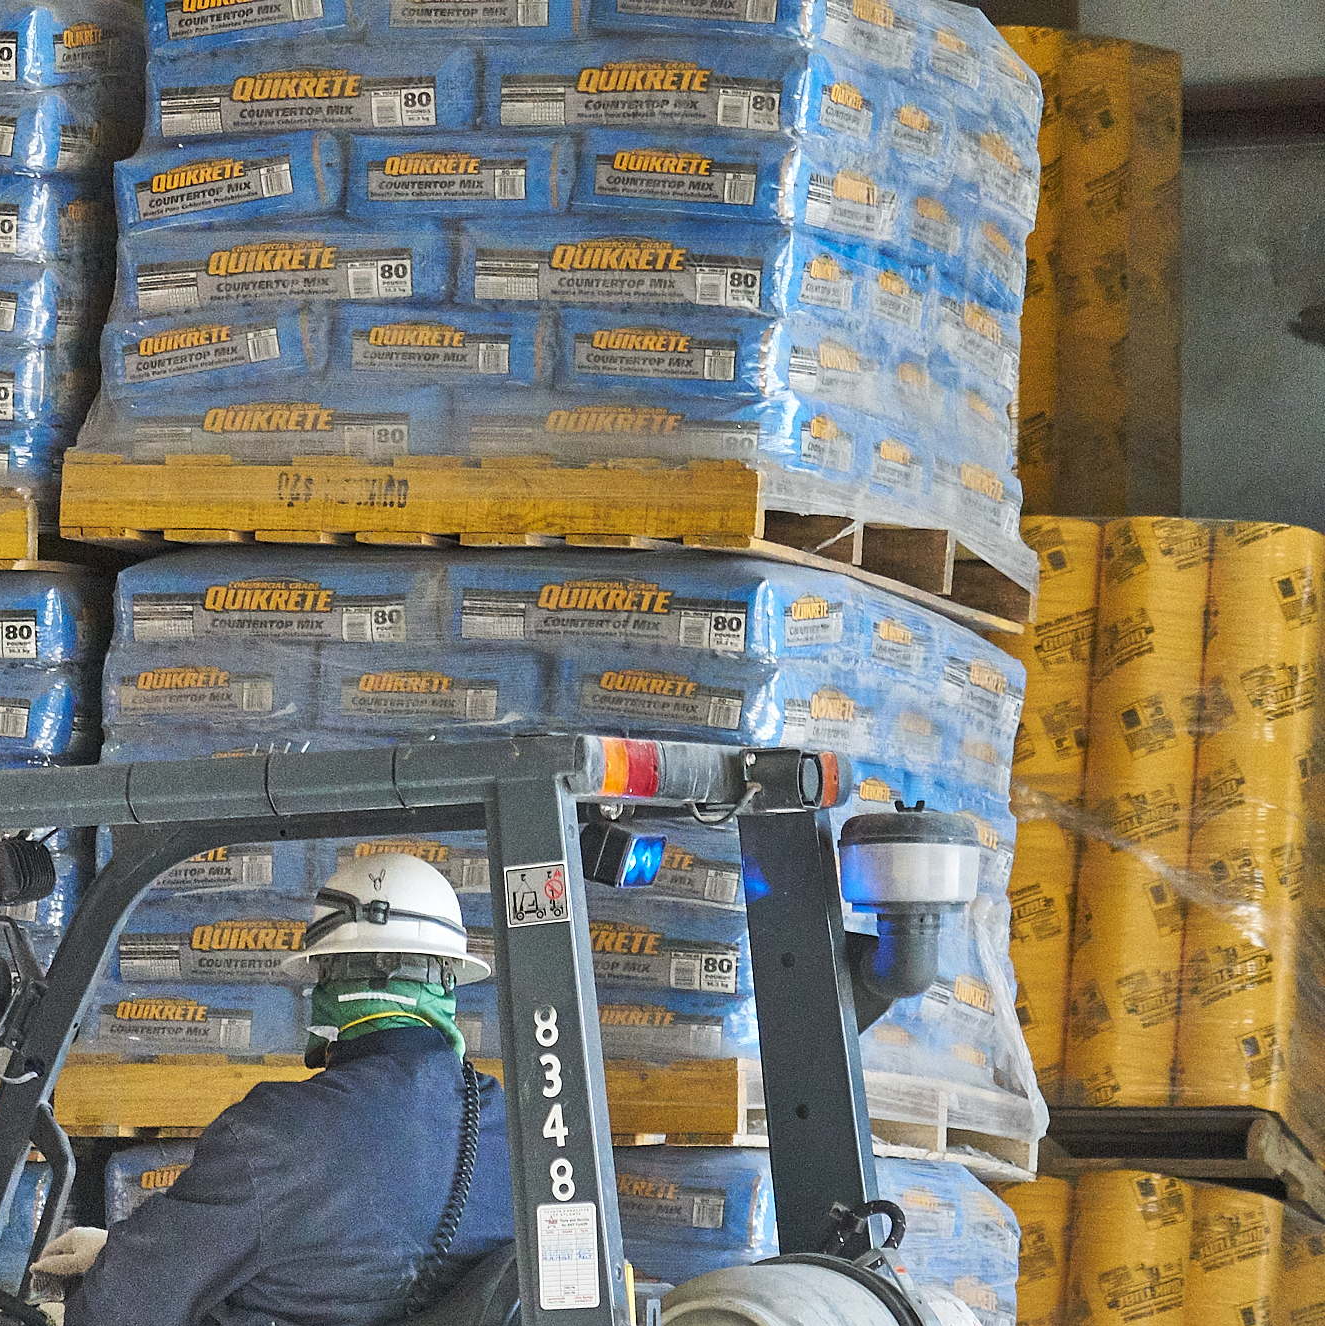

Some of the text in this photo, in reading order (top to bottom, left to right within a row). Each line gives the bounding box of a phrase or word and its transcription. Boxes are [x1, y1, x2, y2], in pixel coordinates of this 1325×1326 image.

[232, 74, 363, 101] QUIKRETE
[577, 67, 712, 93] QUIKRETE
[239, 104, 354, 119] COUNTERTOP MIX
[403, 92, 431, 107] 80
[384, 156, 480, 175] QUIKRETE
[613, 151, 713, 175] QUIKRETE
[152, 160, 245, 193] QUIKRETE
[378, 180, 484, 190] COUNTERTOP MIX
[607, 175, 715, 192] COUNTERTOP MIX
[148, 181, 251, 208] COUNTERTOP MIX
[207, 246, 340, 276] QUIKRETE
[551, 244, 687, 270] QUIKRETE
[380, 263, 408, 280] 80
[729, 272, 757, 289] 80
[205, 584, 333, 613] QUIKRETE
[537, 584, 671, 613] QUIKRETE
[5, 622, 33, 640] 80
[712, 616, 741, 633] 80
[534, 1006, 576, 1202] 8348
